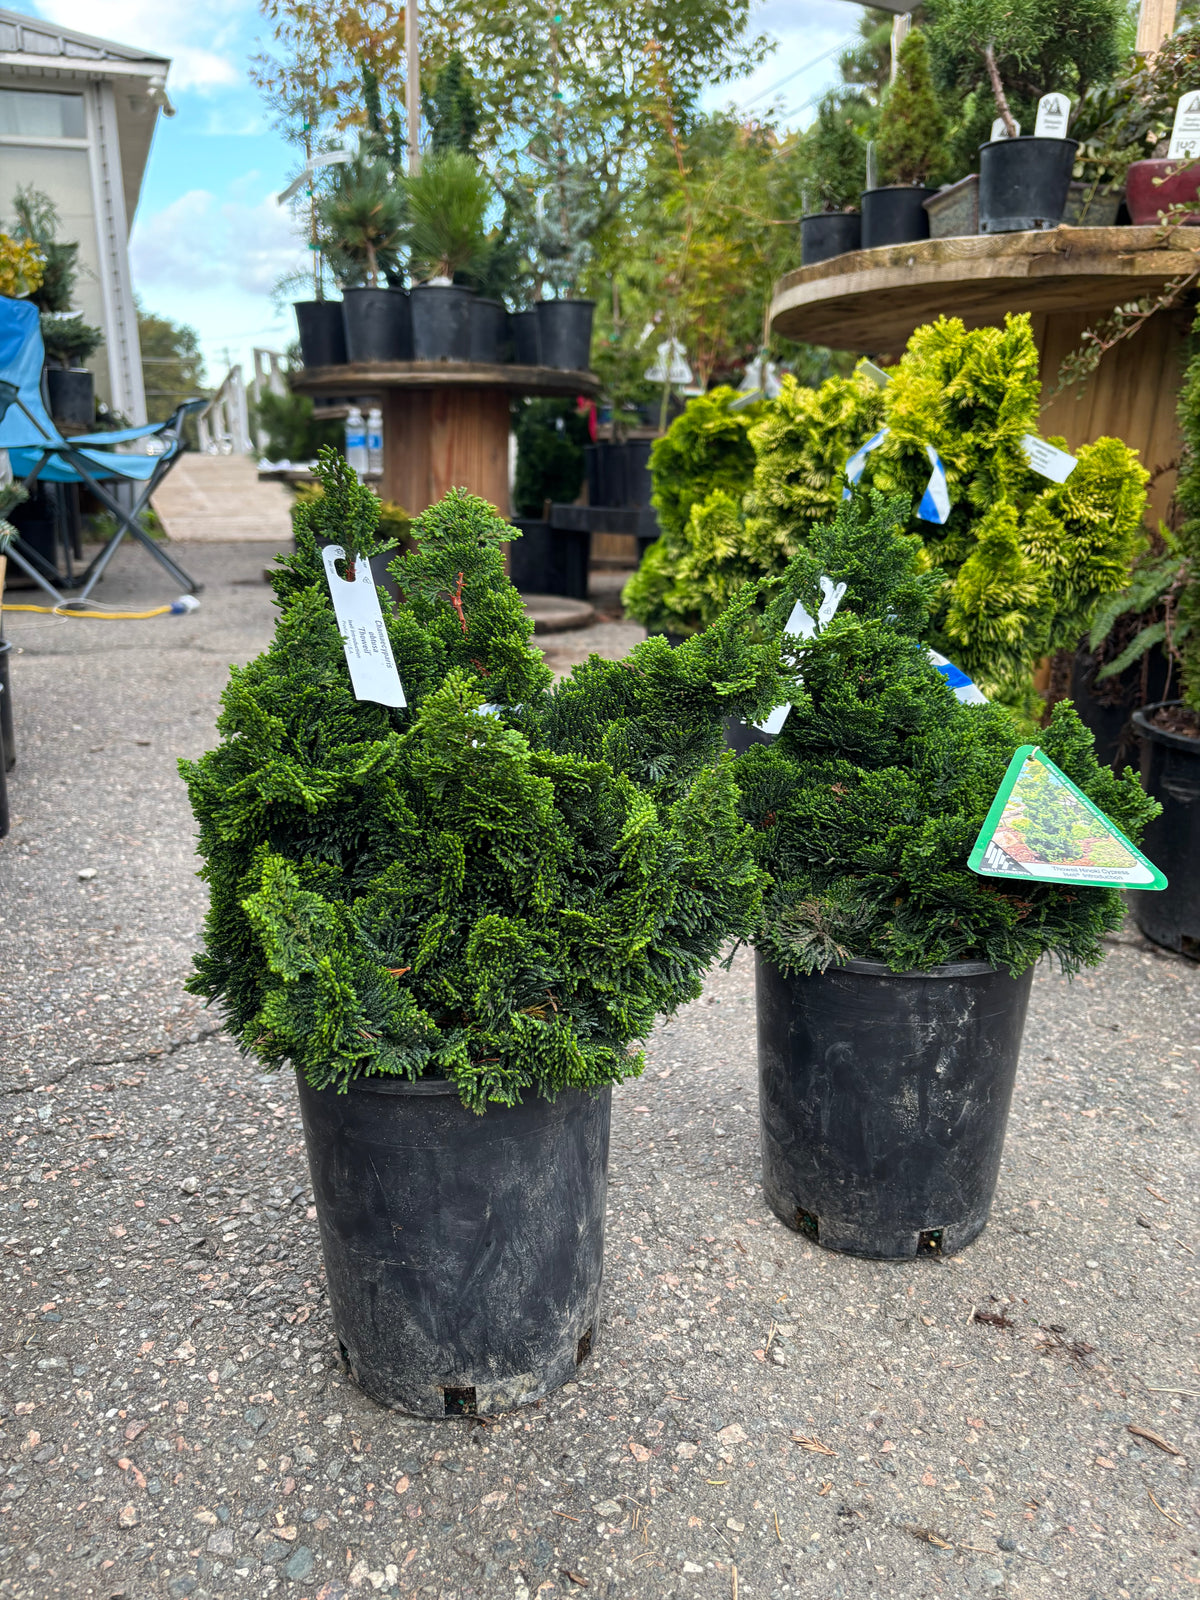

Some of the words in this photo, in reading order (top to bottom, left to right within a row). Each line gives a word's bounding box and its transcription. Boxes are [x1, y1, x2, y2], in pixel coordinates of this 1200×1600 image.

[368, 631, 379, 653] obtusa
[375, 620, 392, 668] Chamaecyparis
[1045, 763, 1059, 776] Where
